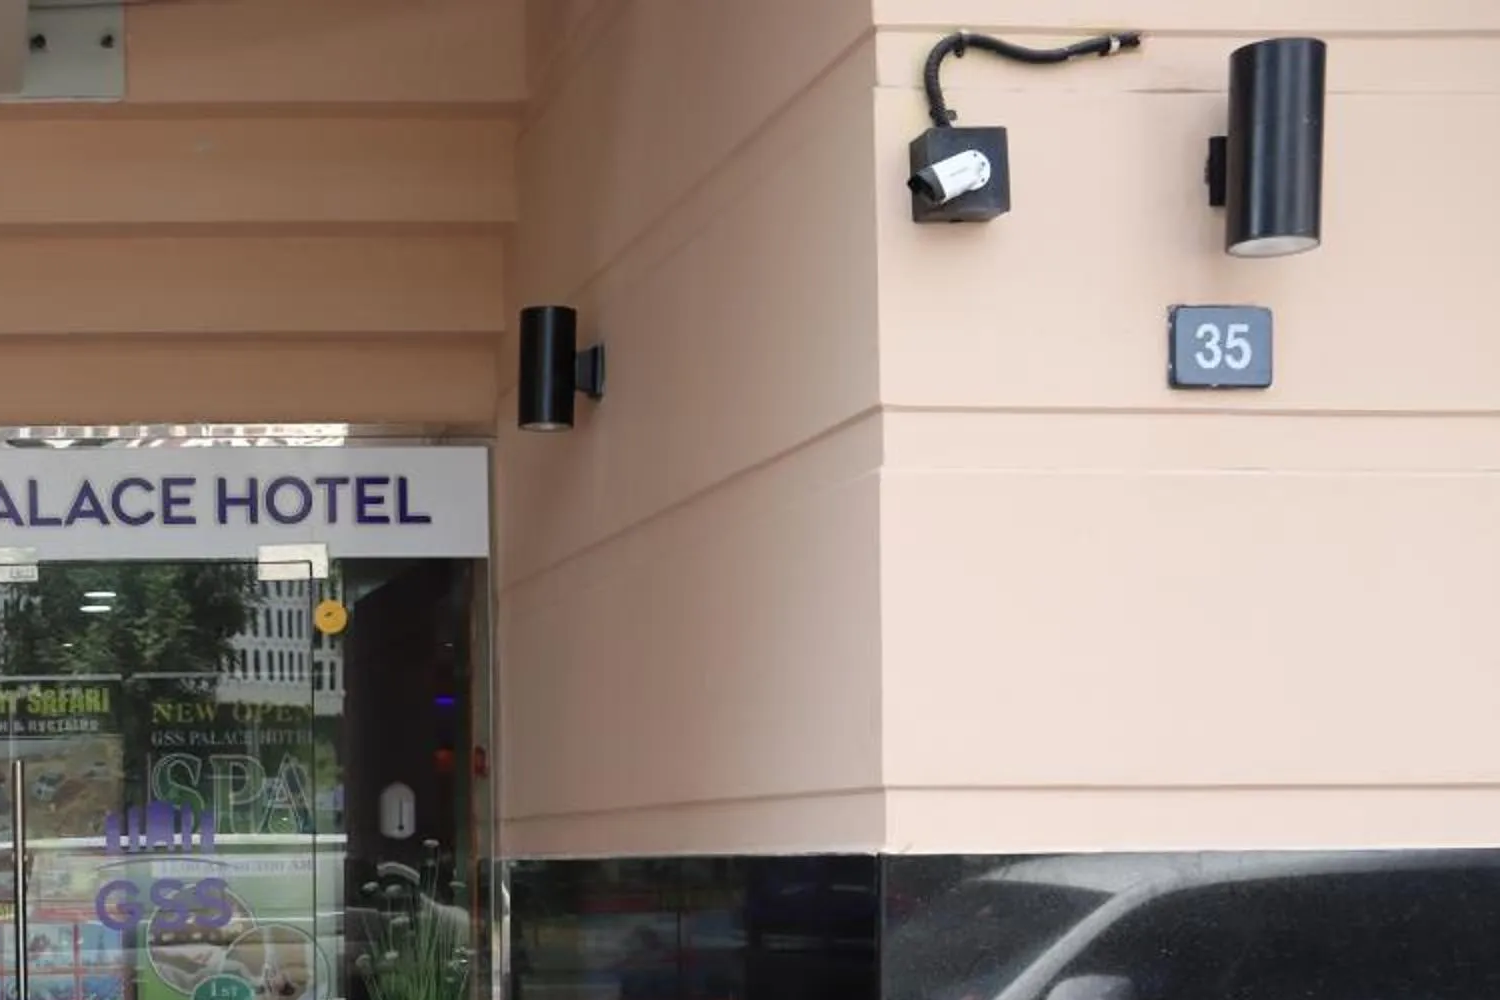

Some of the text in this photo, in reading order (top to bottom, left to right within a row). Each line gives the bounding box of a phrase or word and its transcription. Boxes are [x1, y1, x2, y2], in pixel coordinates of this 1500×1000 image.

[1194, 322, 1252, 370] 35
[215, 475, 432, 526] HOTEL
[26, 685, 111, 716] SAFARI
[151, 701, 218, 724] NEW
[151, 729, 186, 747] GSS
[189, 729, 249, 746] PALACE
[152, 751, 319, 836] SPA
[95, 876, 234, 931] GSS
